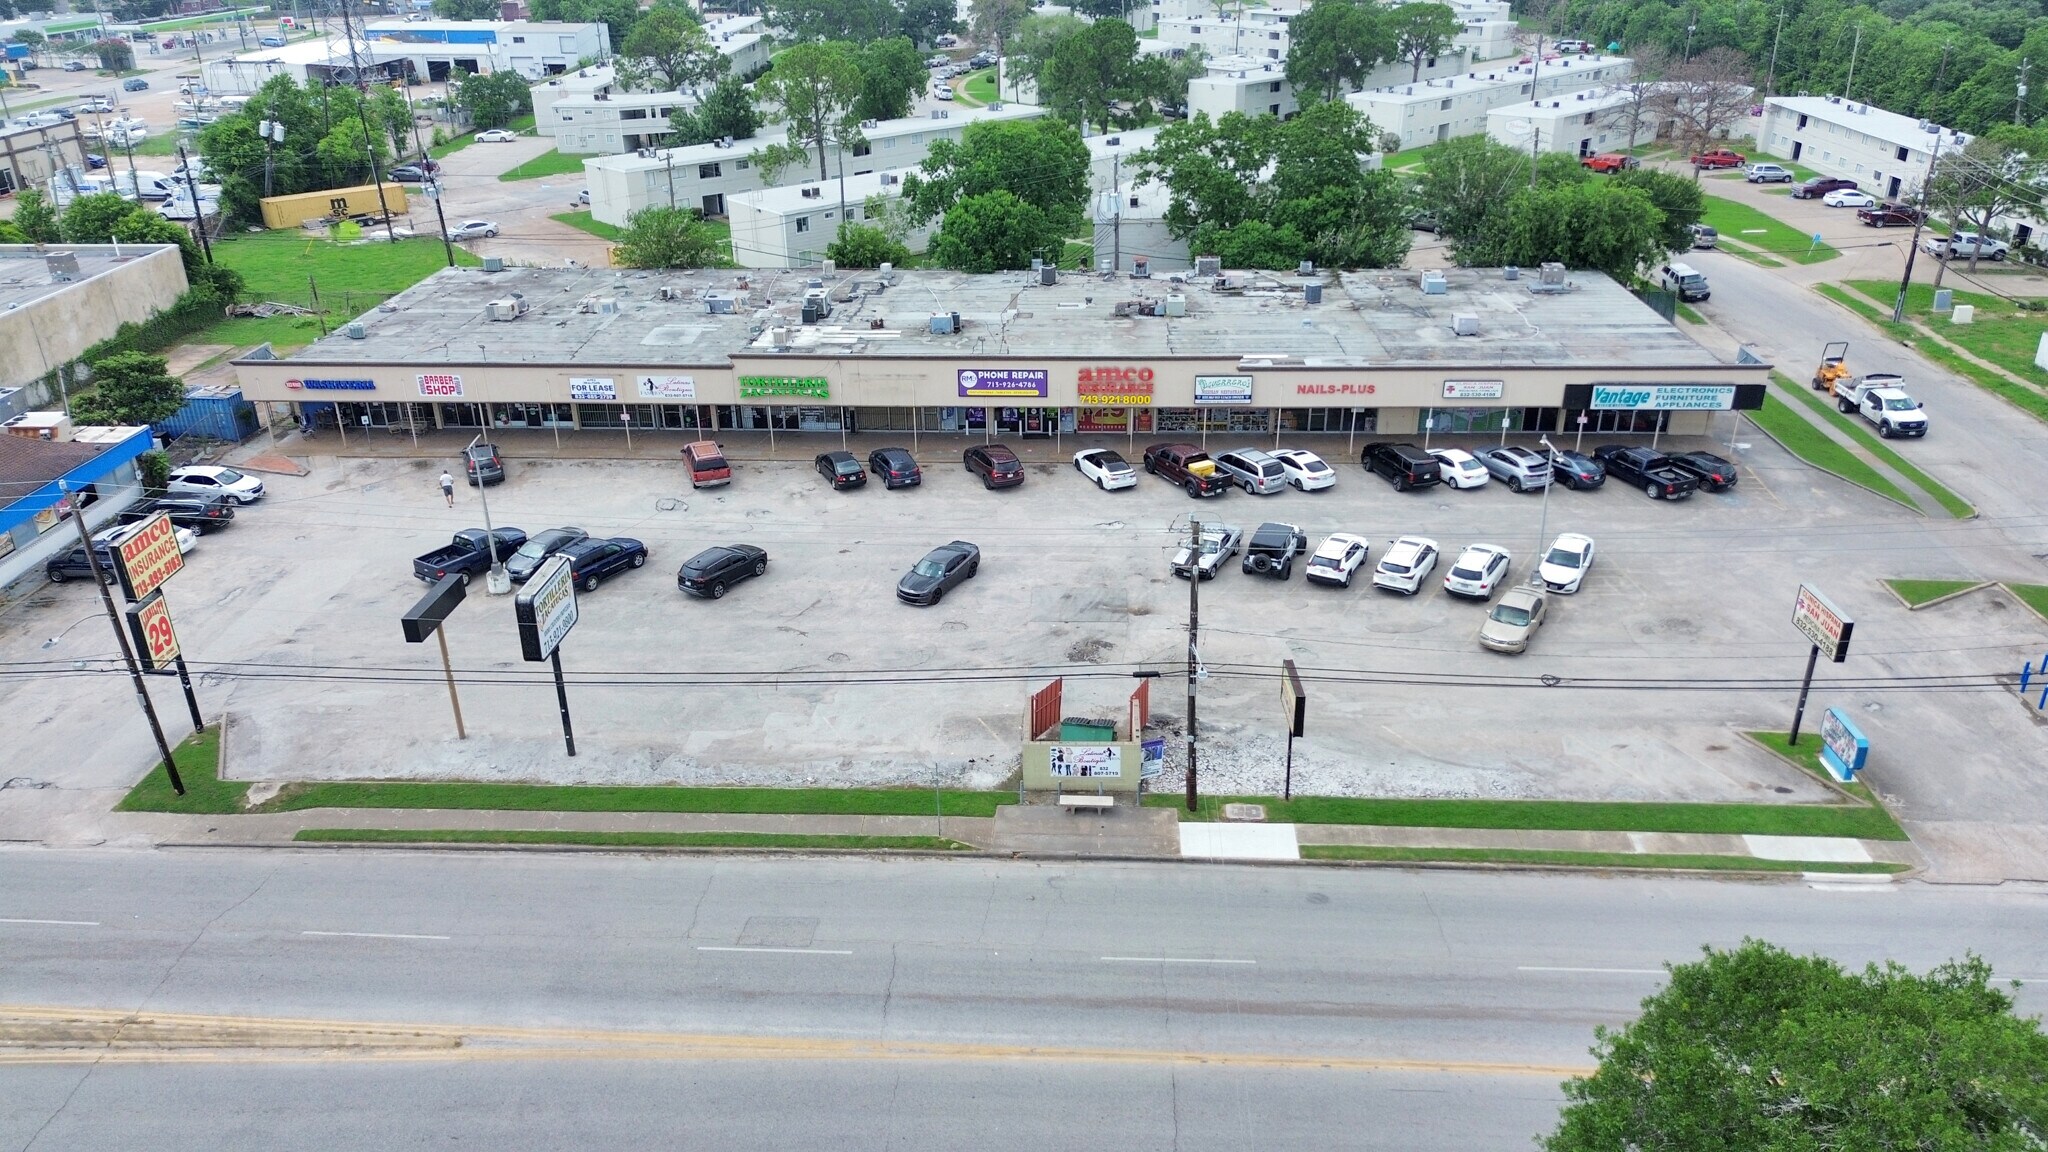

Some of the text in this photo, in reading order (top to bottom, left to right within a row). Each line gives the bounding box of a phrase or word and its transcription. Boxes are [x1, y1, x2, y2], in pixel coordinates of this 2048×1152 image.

[423, 375, 454, 385] BARBER
[738, 376, 828, 388] TORTILLERIA
[978, 371, 1044, 379] PHONE REPAIR
[1077, 366, 1154, 382] amco
[426, 386, 456, 395] SHOP
[1077, 383, 1154, 394] INSURANCE
[1297, 384, 1375, 394] NAILS-PLUS
[1595, 388, 1650, 406] Vantage
[123, 517, 170, 563] amco
[128, 536, 177, 581] INSURANCE
[535, 570, 571, 617] TORTILLERIA
[541, 585, 569, 624] ZACATECAS
[1802, 591, 1841, 629] CLINICA HISPANA
[1806, 604, 1839, 639] SAN JUAN
